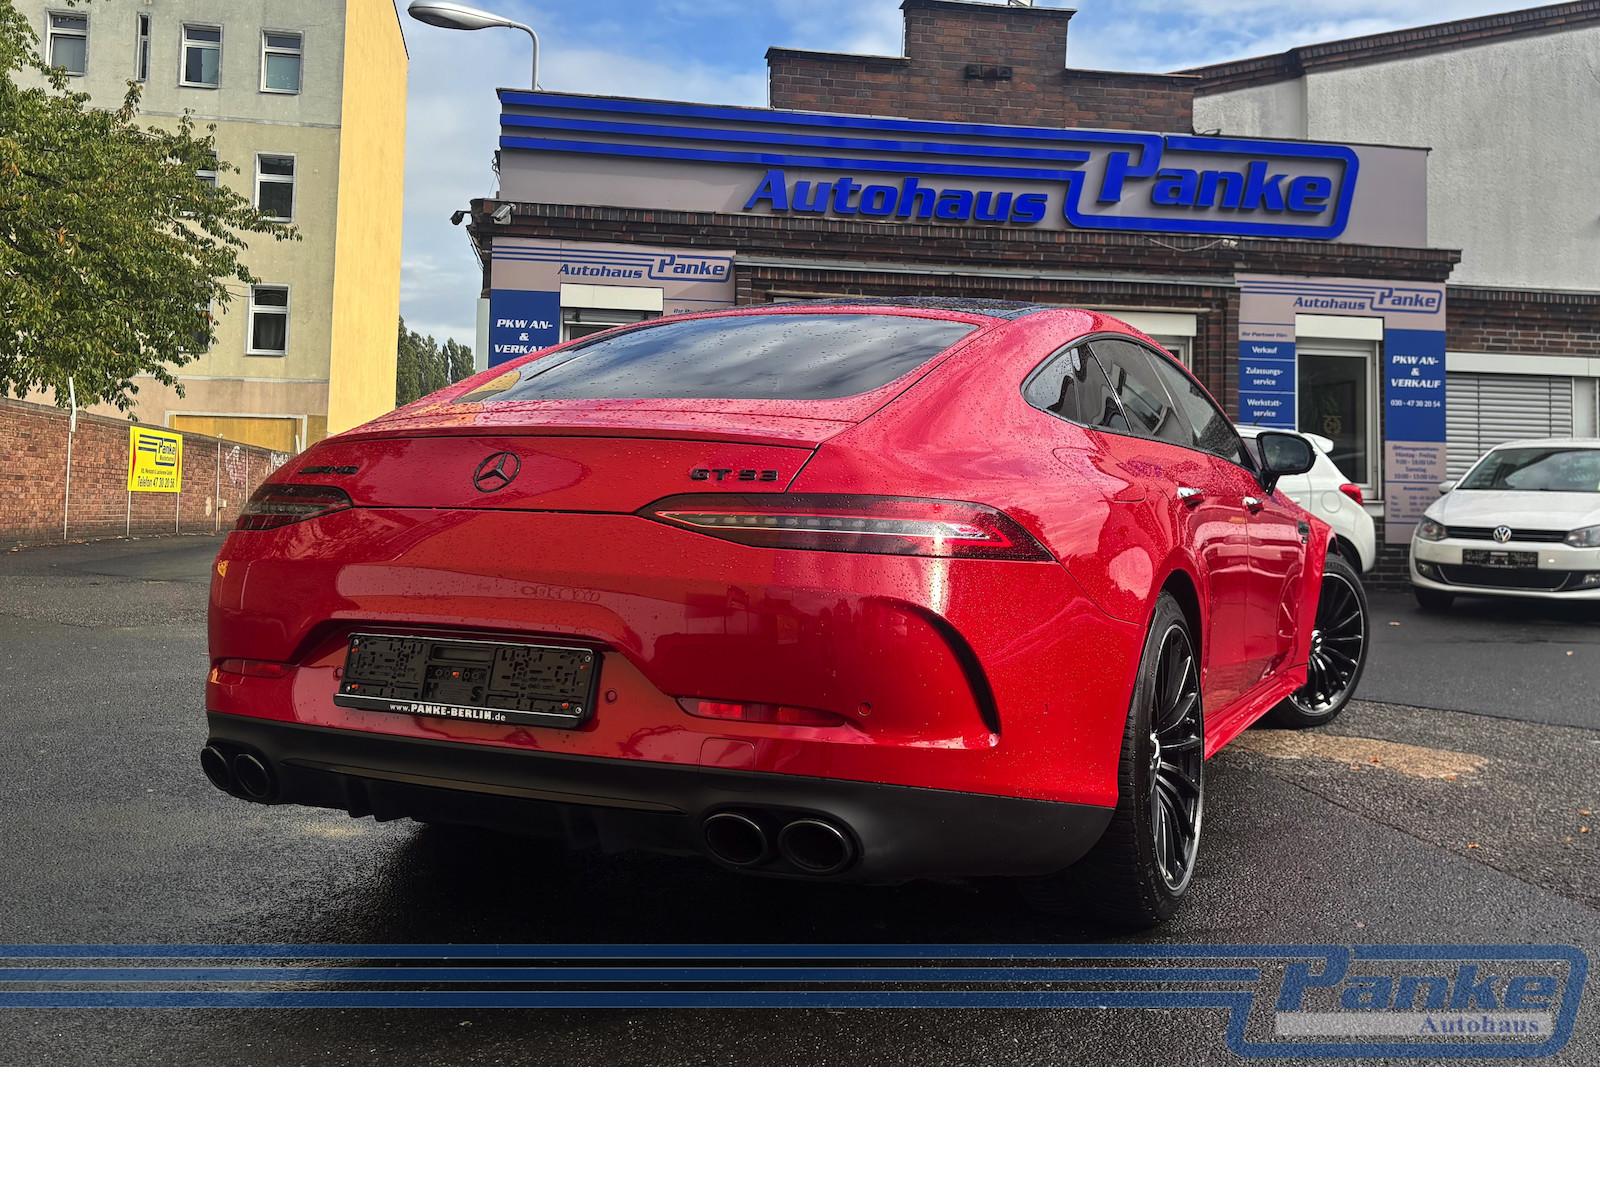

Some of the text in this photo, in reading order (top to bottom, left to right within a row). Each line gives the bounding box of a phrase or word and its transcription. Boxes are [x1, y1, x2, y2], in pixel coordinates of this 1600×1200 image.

[744, 136, 1333, 224] Autohaus Panke
[558, 254, 725, 279] Autohaus Panke
[1293, 288, 1437, 310] Autohaus Panke
[497, 319, 554, 330] PKW AN-
[519, 332, 530, 342] &
[494, 344, 548, 355] VERKA
[1251, 345, 1278, 354] Verkauf
[1392, 355, 1440, 366] PKW AN-
[1245, 366, 1284, 377] Zulassungs-
[1410, 367, 1420, 377] &
[1253, 378, 1277, 386] service
[1391, 378, 1442, 389] VERKAUF
[1246, 398, 1283, 407] Werkstatt-
[1253, 409, 1277, 418] service
[691, 468, 733, 481] GT
[389, 703, 507, 722] www.PANKE-BERLIN.de
